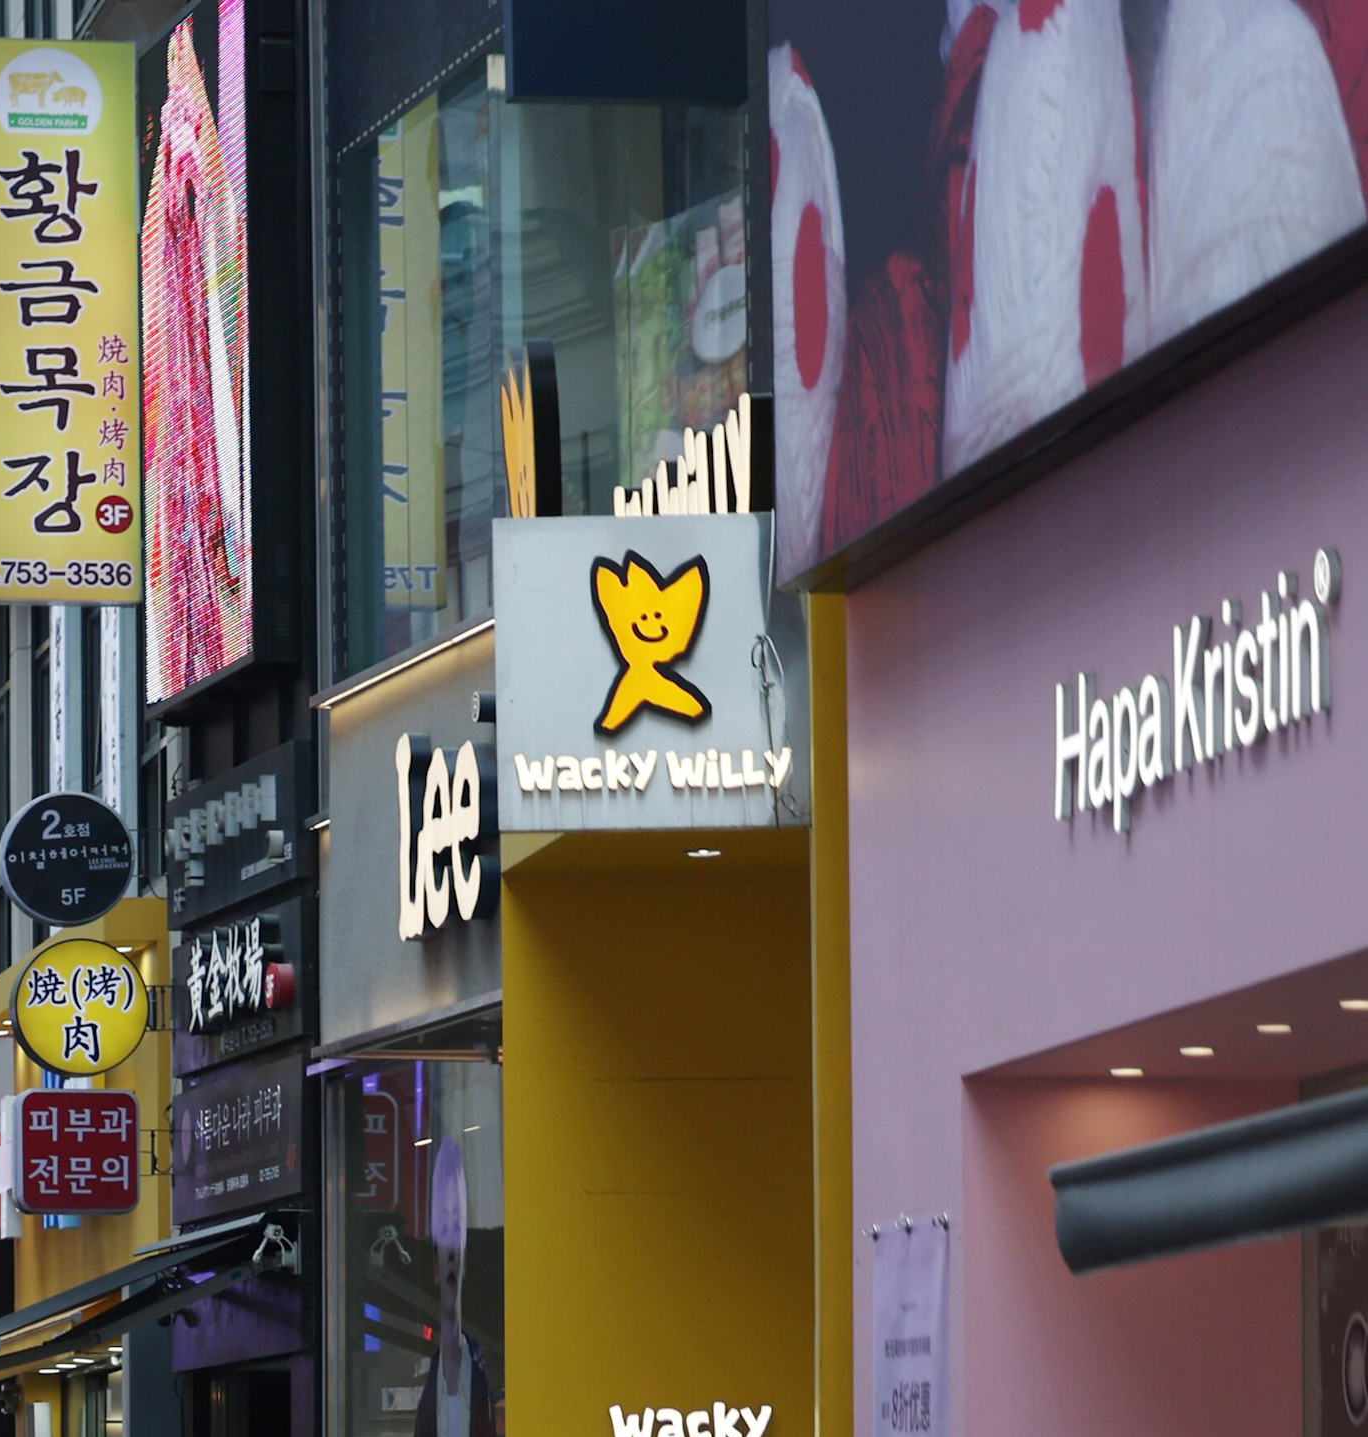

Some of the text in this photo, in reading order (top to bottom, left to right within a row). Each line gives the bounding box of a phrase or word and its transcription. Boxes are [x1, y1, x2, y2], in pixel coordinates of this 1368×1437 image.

[97, 503, 130, 526] 3F
[1055, 671, 1165, 833] Hapa
[394, 732, 481, 943] Lee
[61, 887, 86, 906] 5F
[28, 1106, 133, 1143] 피부과
[28, 1155, 131, 1196] 전문의
